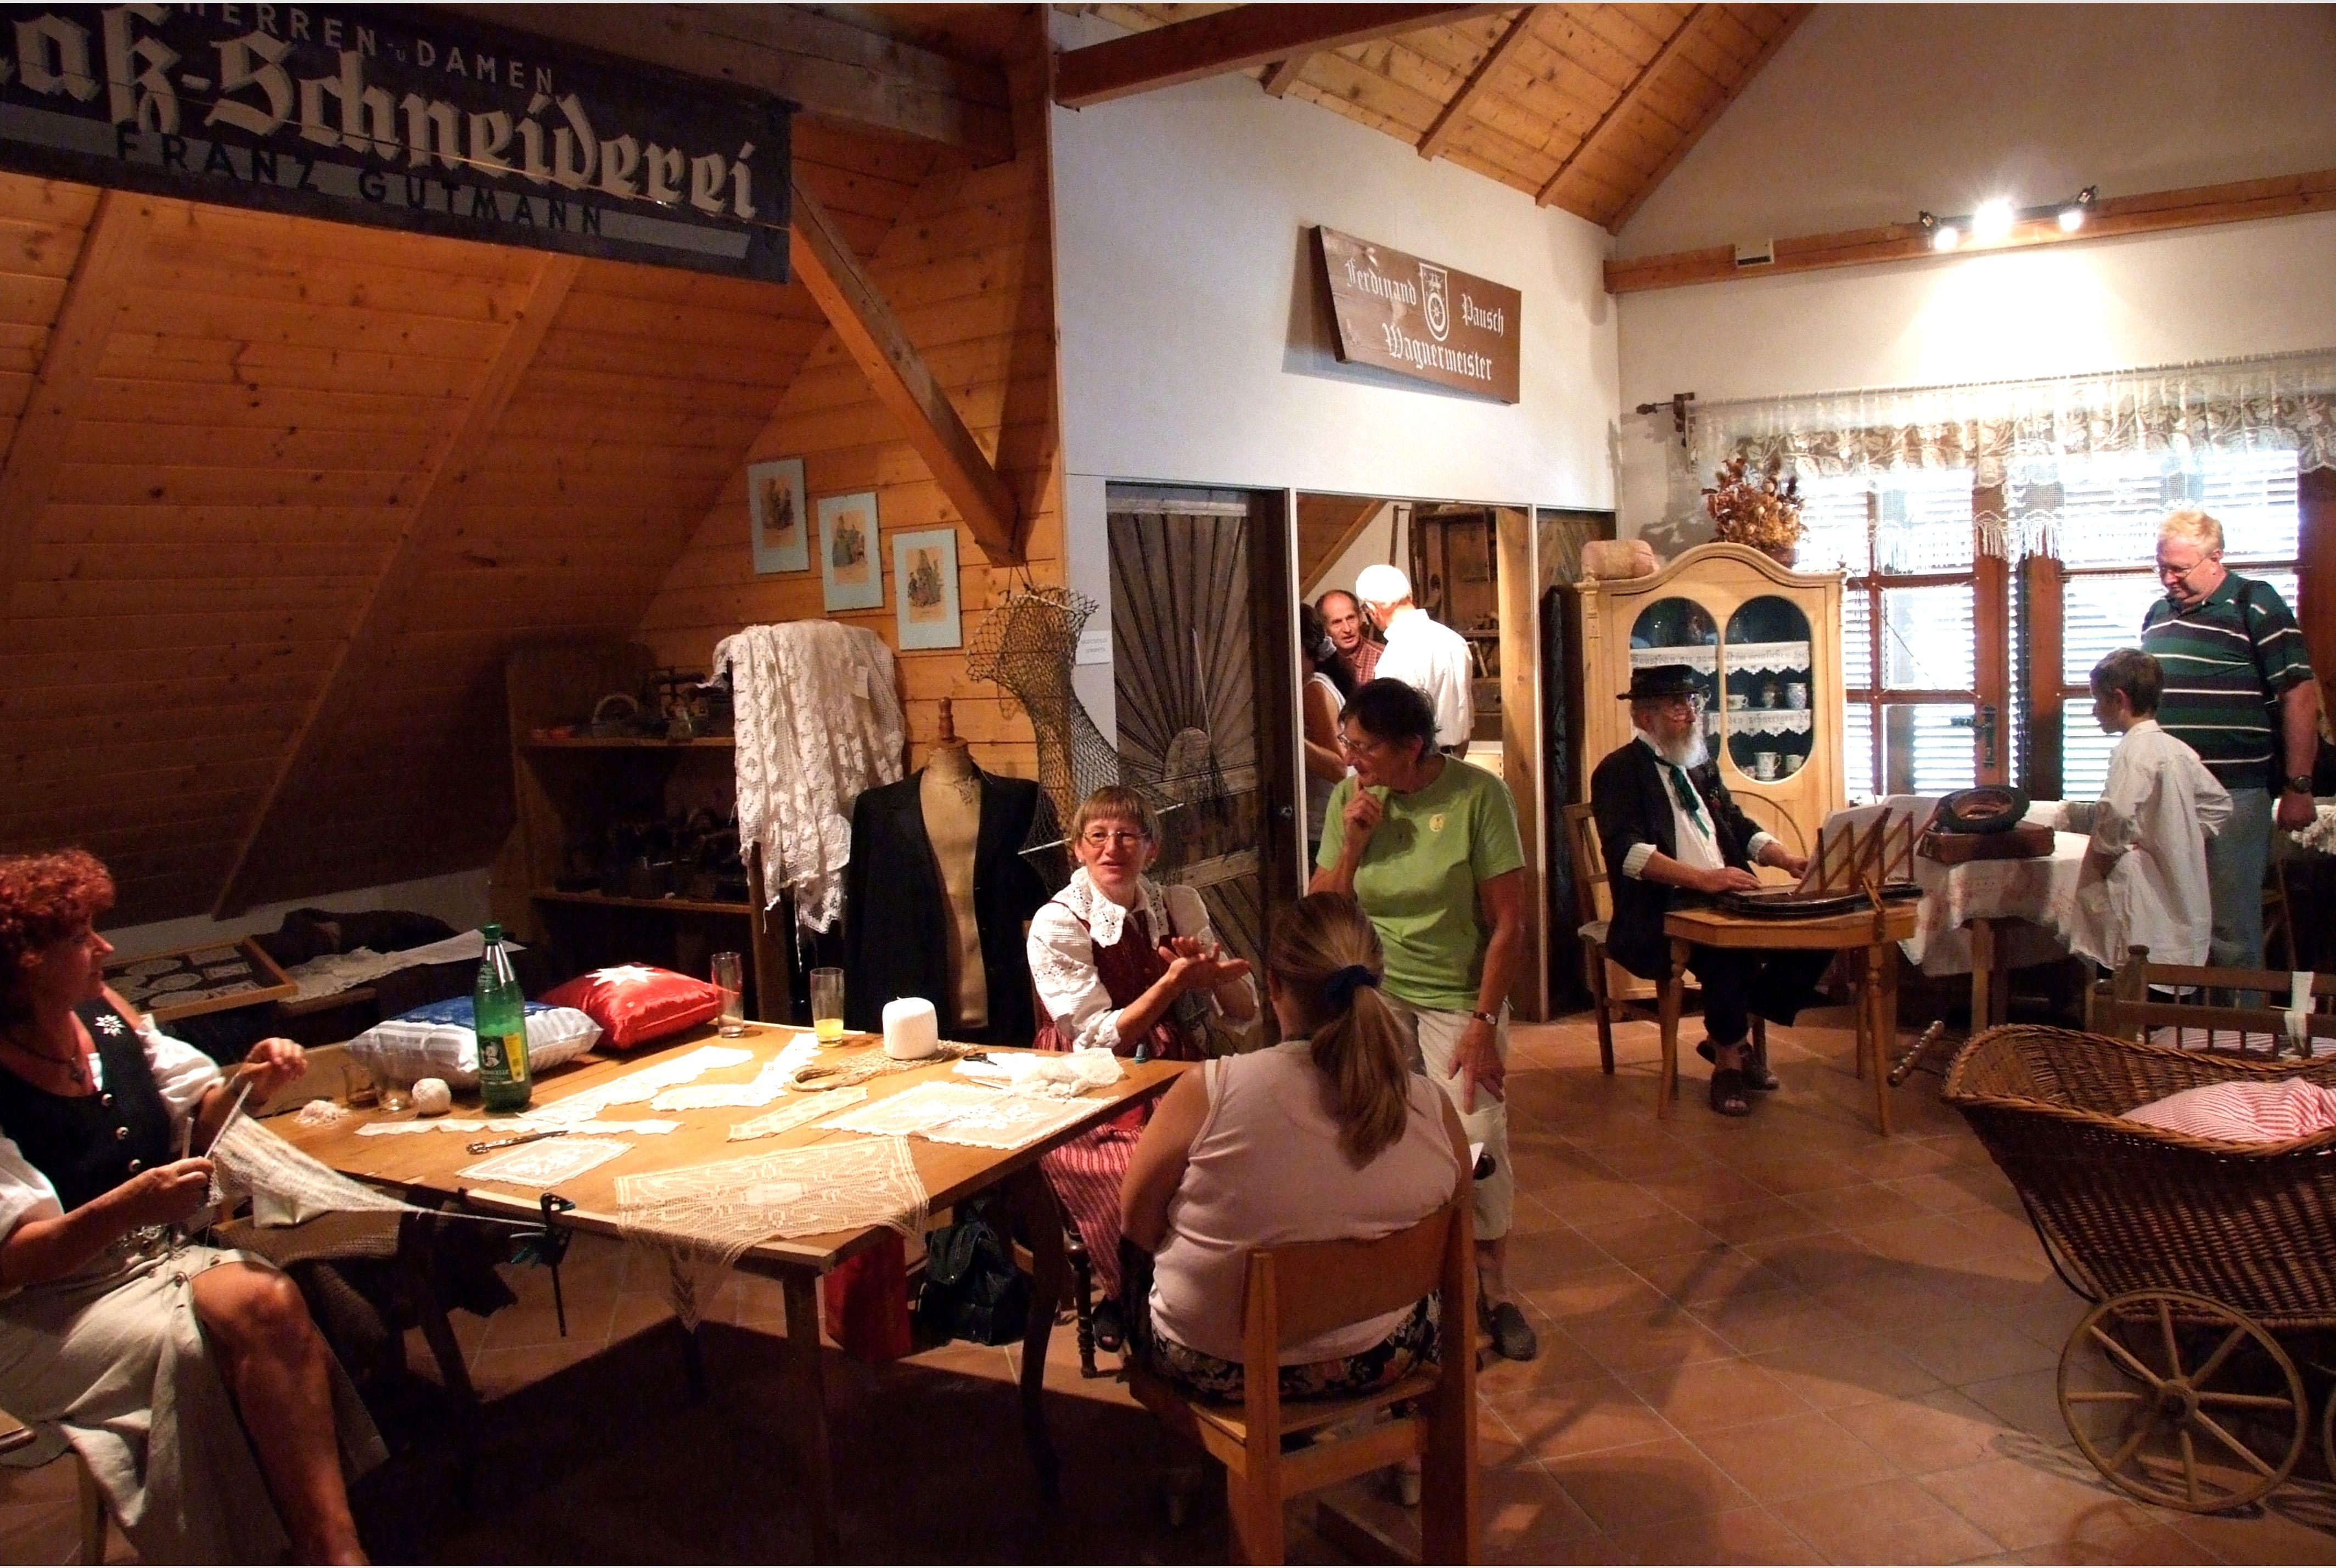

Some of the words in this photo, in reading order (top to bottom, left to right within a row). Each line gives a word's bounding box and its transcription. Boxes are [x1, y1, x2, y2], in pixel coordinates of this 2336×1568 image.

[417, 39, 552, 95] DAMEN
[0, 3, 756, 220] aß-Schneiderei
[116, 121, 317, 192] FRANZ
[358, 169, 602, 237] GUTMANN
[1345, 257, 1416, 306] Ferdinand
[1461, 293, 1504, 337] Pausch
[1383, 323, 1492, 380] Wagnermeister
